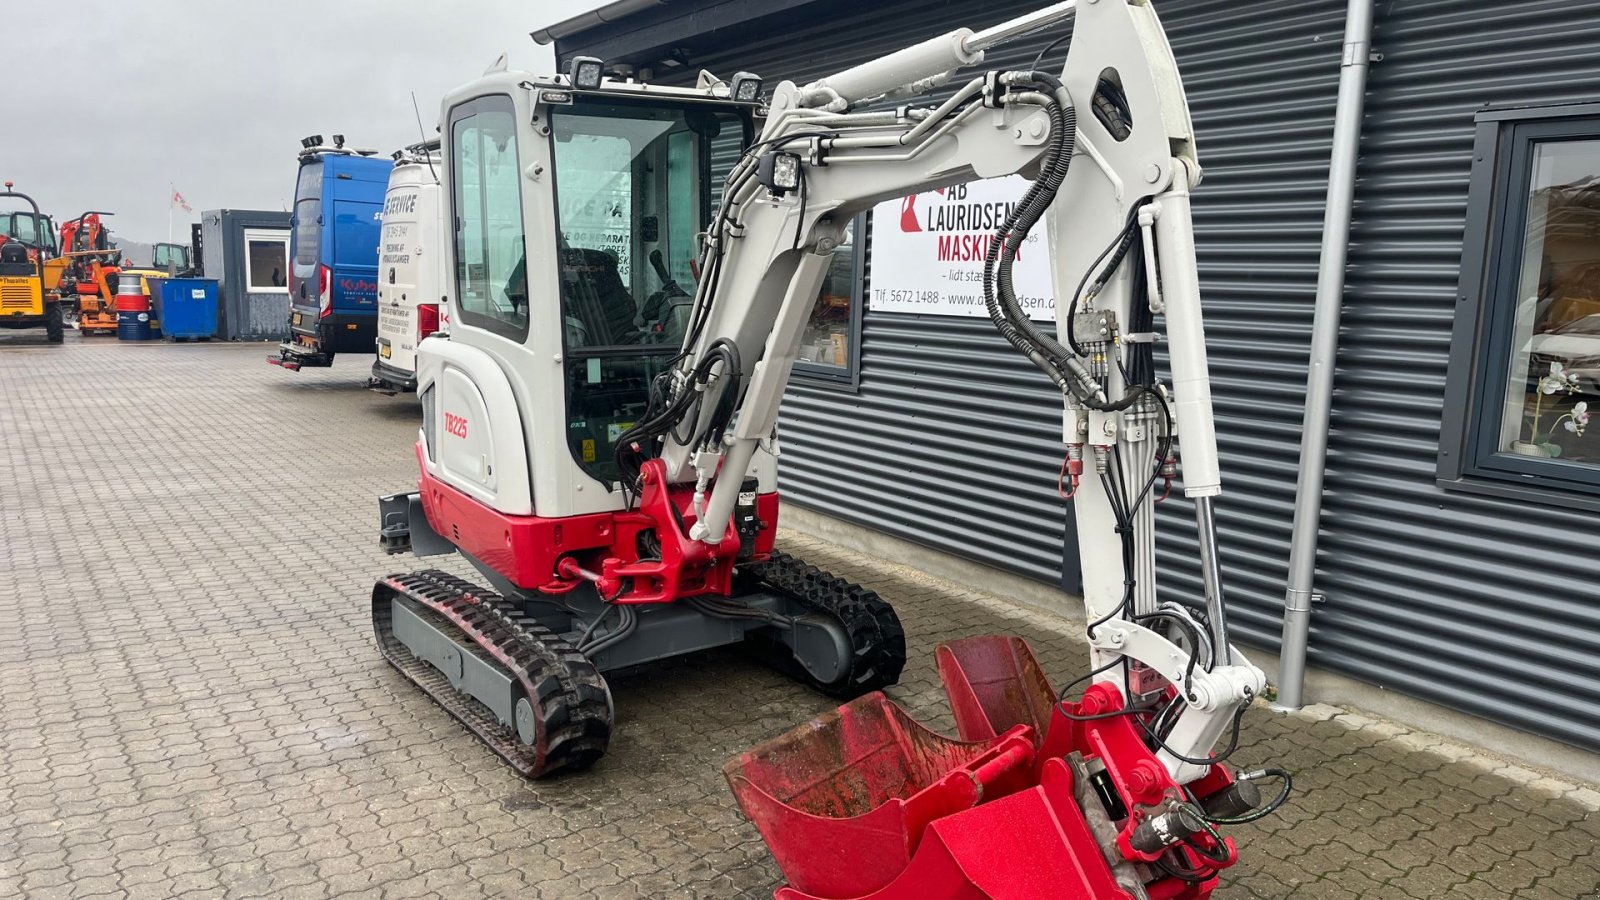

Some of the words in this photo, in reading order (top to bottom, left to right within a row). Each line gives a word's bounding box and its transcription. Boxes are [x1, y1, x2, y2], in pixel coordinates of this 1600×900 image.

[947, 183, 967, 201] AB
[949, 269, 963, 281] lidt
[891, 289, 913, 303] 5672
[916, 290, 939, 304] 1488
[445, 412, 468, 439] TB225
